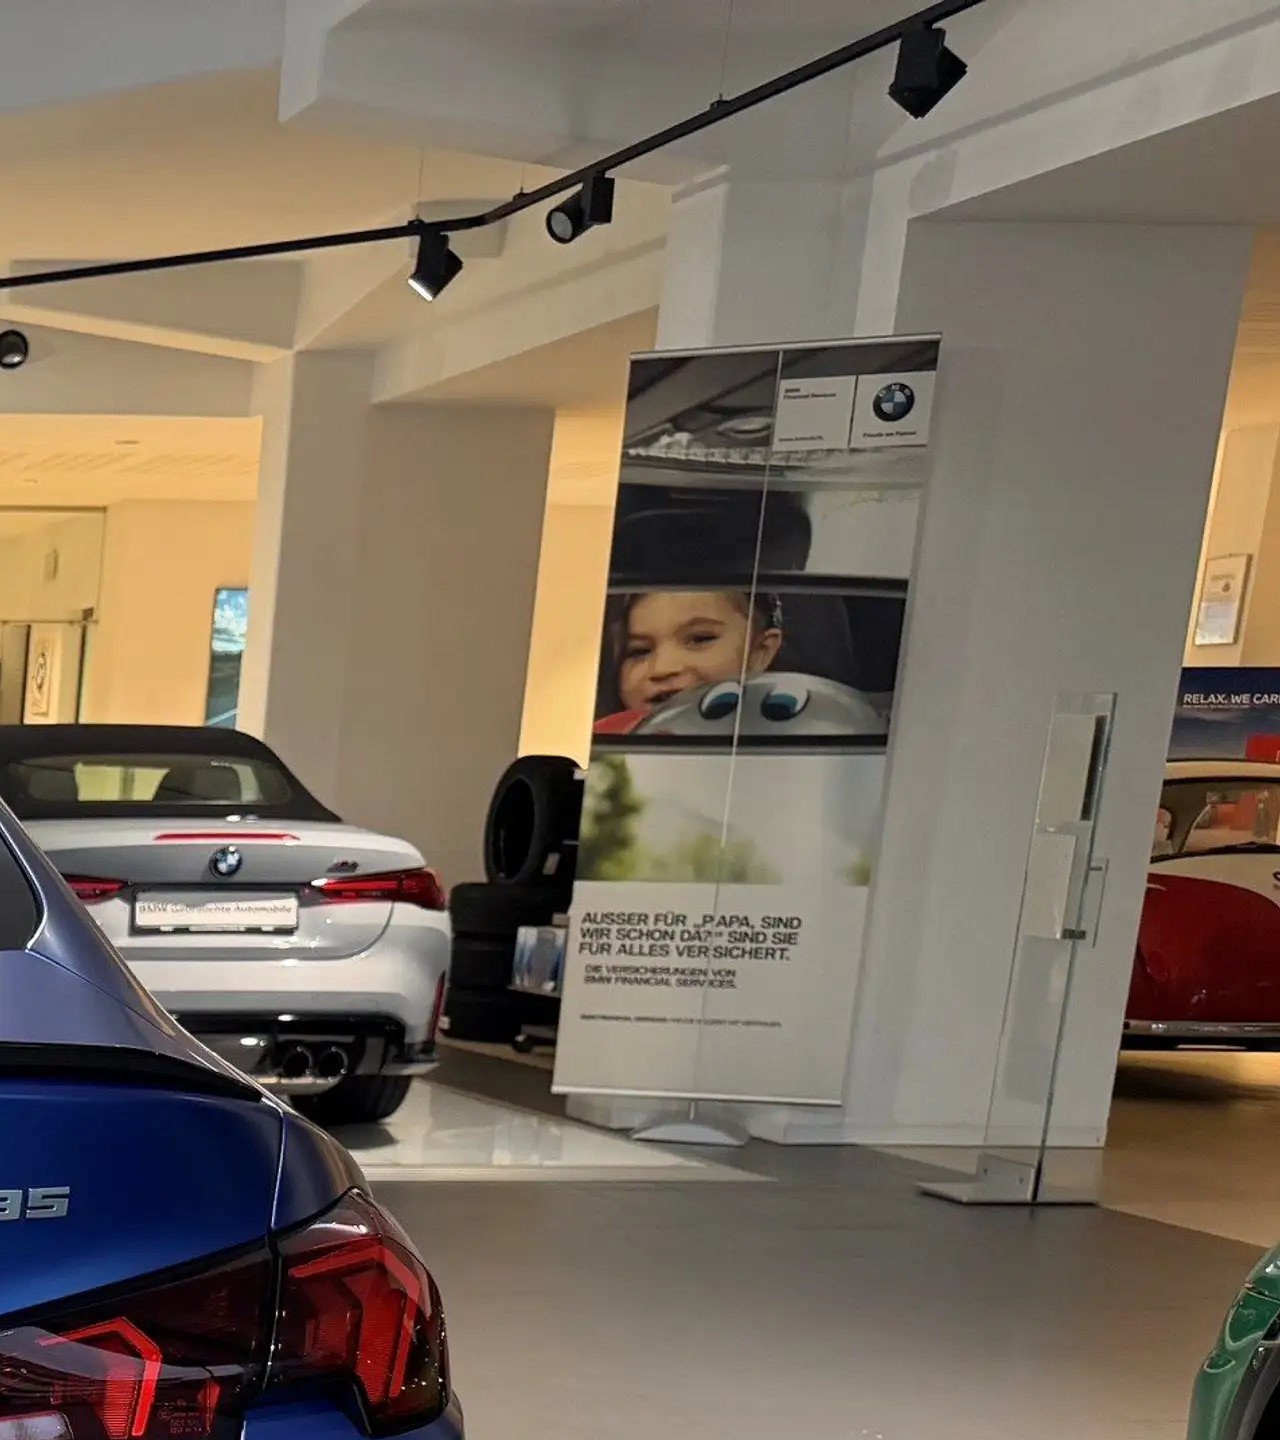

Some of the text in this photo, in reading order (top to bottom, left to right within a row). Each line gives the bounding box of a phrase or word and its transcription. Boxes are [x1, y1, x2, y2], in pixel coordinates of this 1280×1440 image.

[1183, 693, 1228, 704] RELAX.
[1231, 693, 1252, 704] WE
[581, 911, 649, 926] AUSSER
[653, 911, 688, 927] FÜR
[760, 915, 802, 930] SIND
[580, 927, 611, 941] WIR
[615, 927, 676, 942] SCHON
[727, 931, 768, 945] SIND
[771, 931, 800, 946] SIE
[615, 942, 671, 958] ALLES
[674, 944, 791, 961] VERSICHERT.
